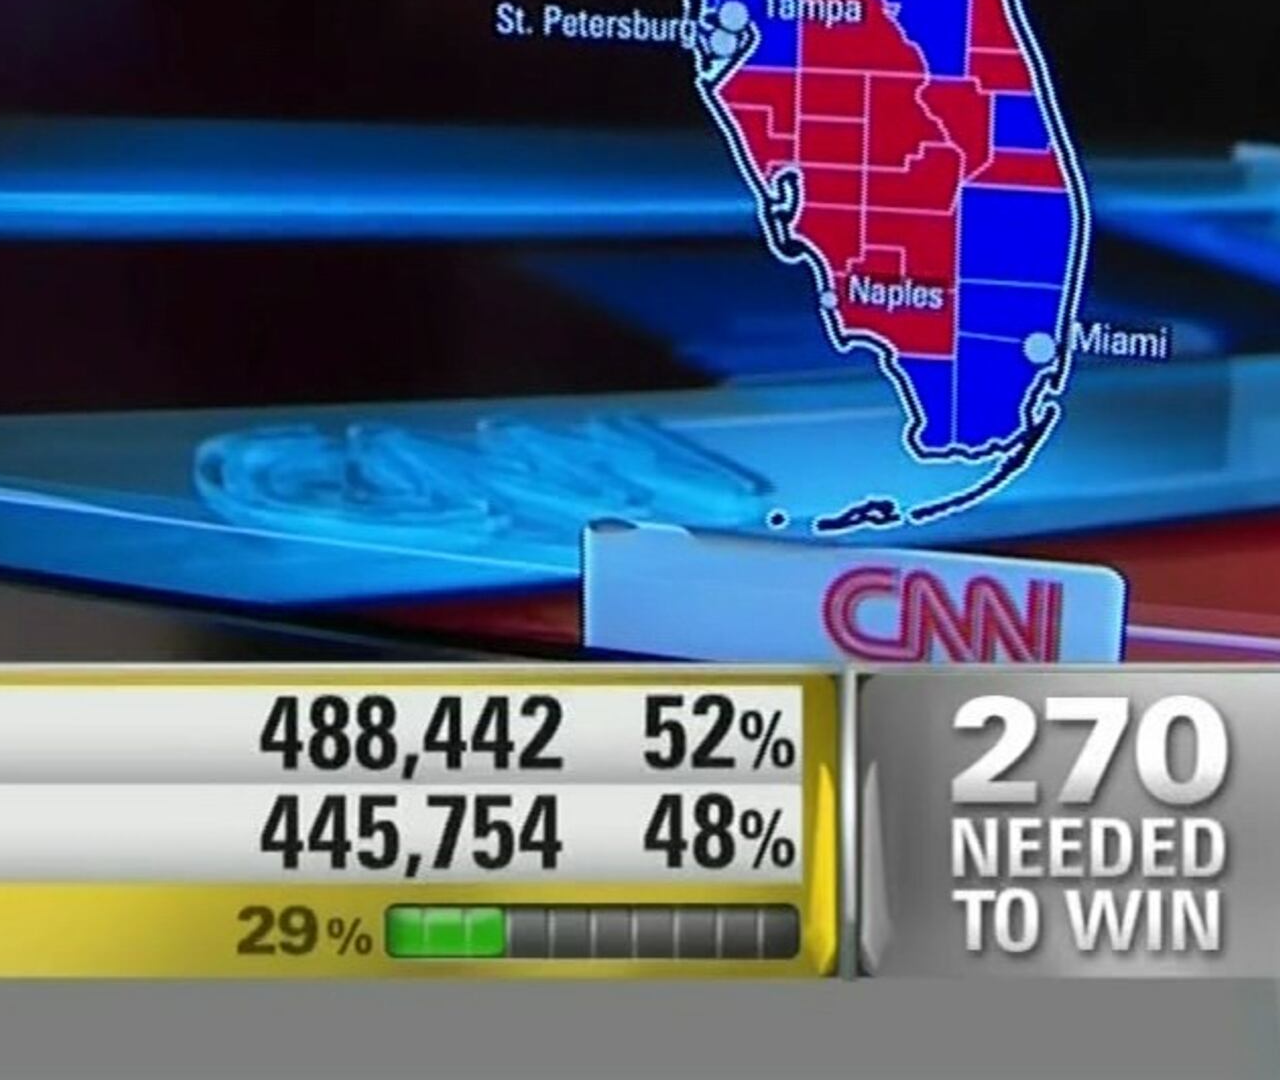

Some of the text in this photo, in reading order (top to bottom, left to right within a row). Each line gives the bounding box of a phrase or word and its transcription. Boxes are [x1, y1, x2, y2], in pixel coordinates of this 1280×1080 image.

[495, 3, 698, 50] St. Petersburg
[848, 277, 944, 310] Naples
[1071, 321, 1169, 360] Miami
[823, 566, 1063, 663] CNN
